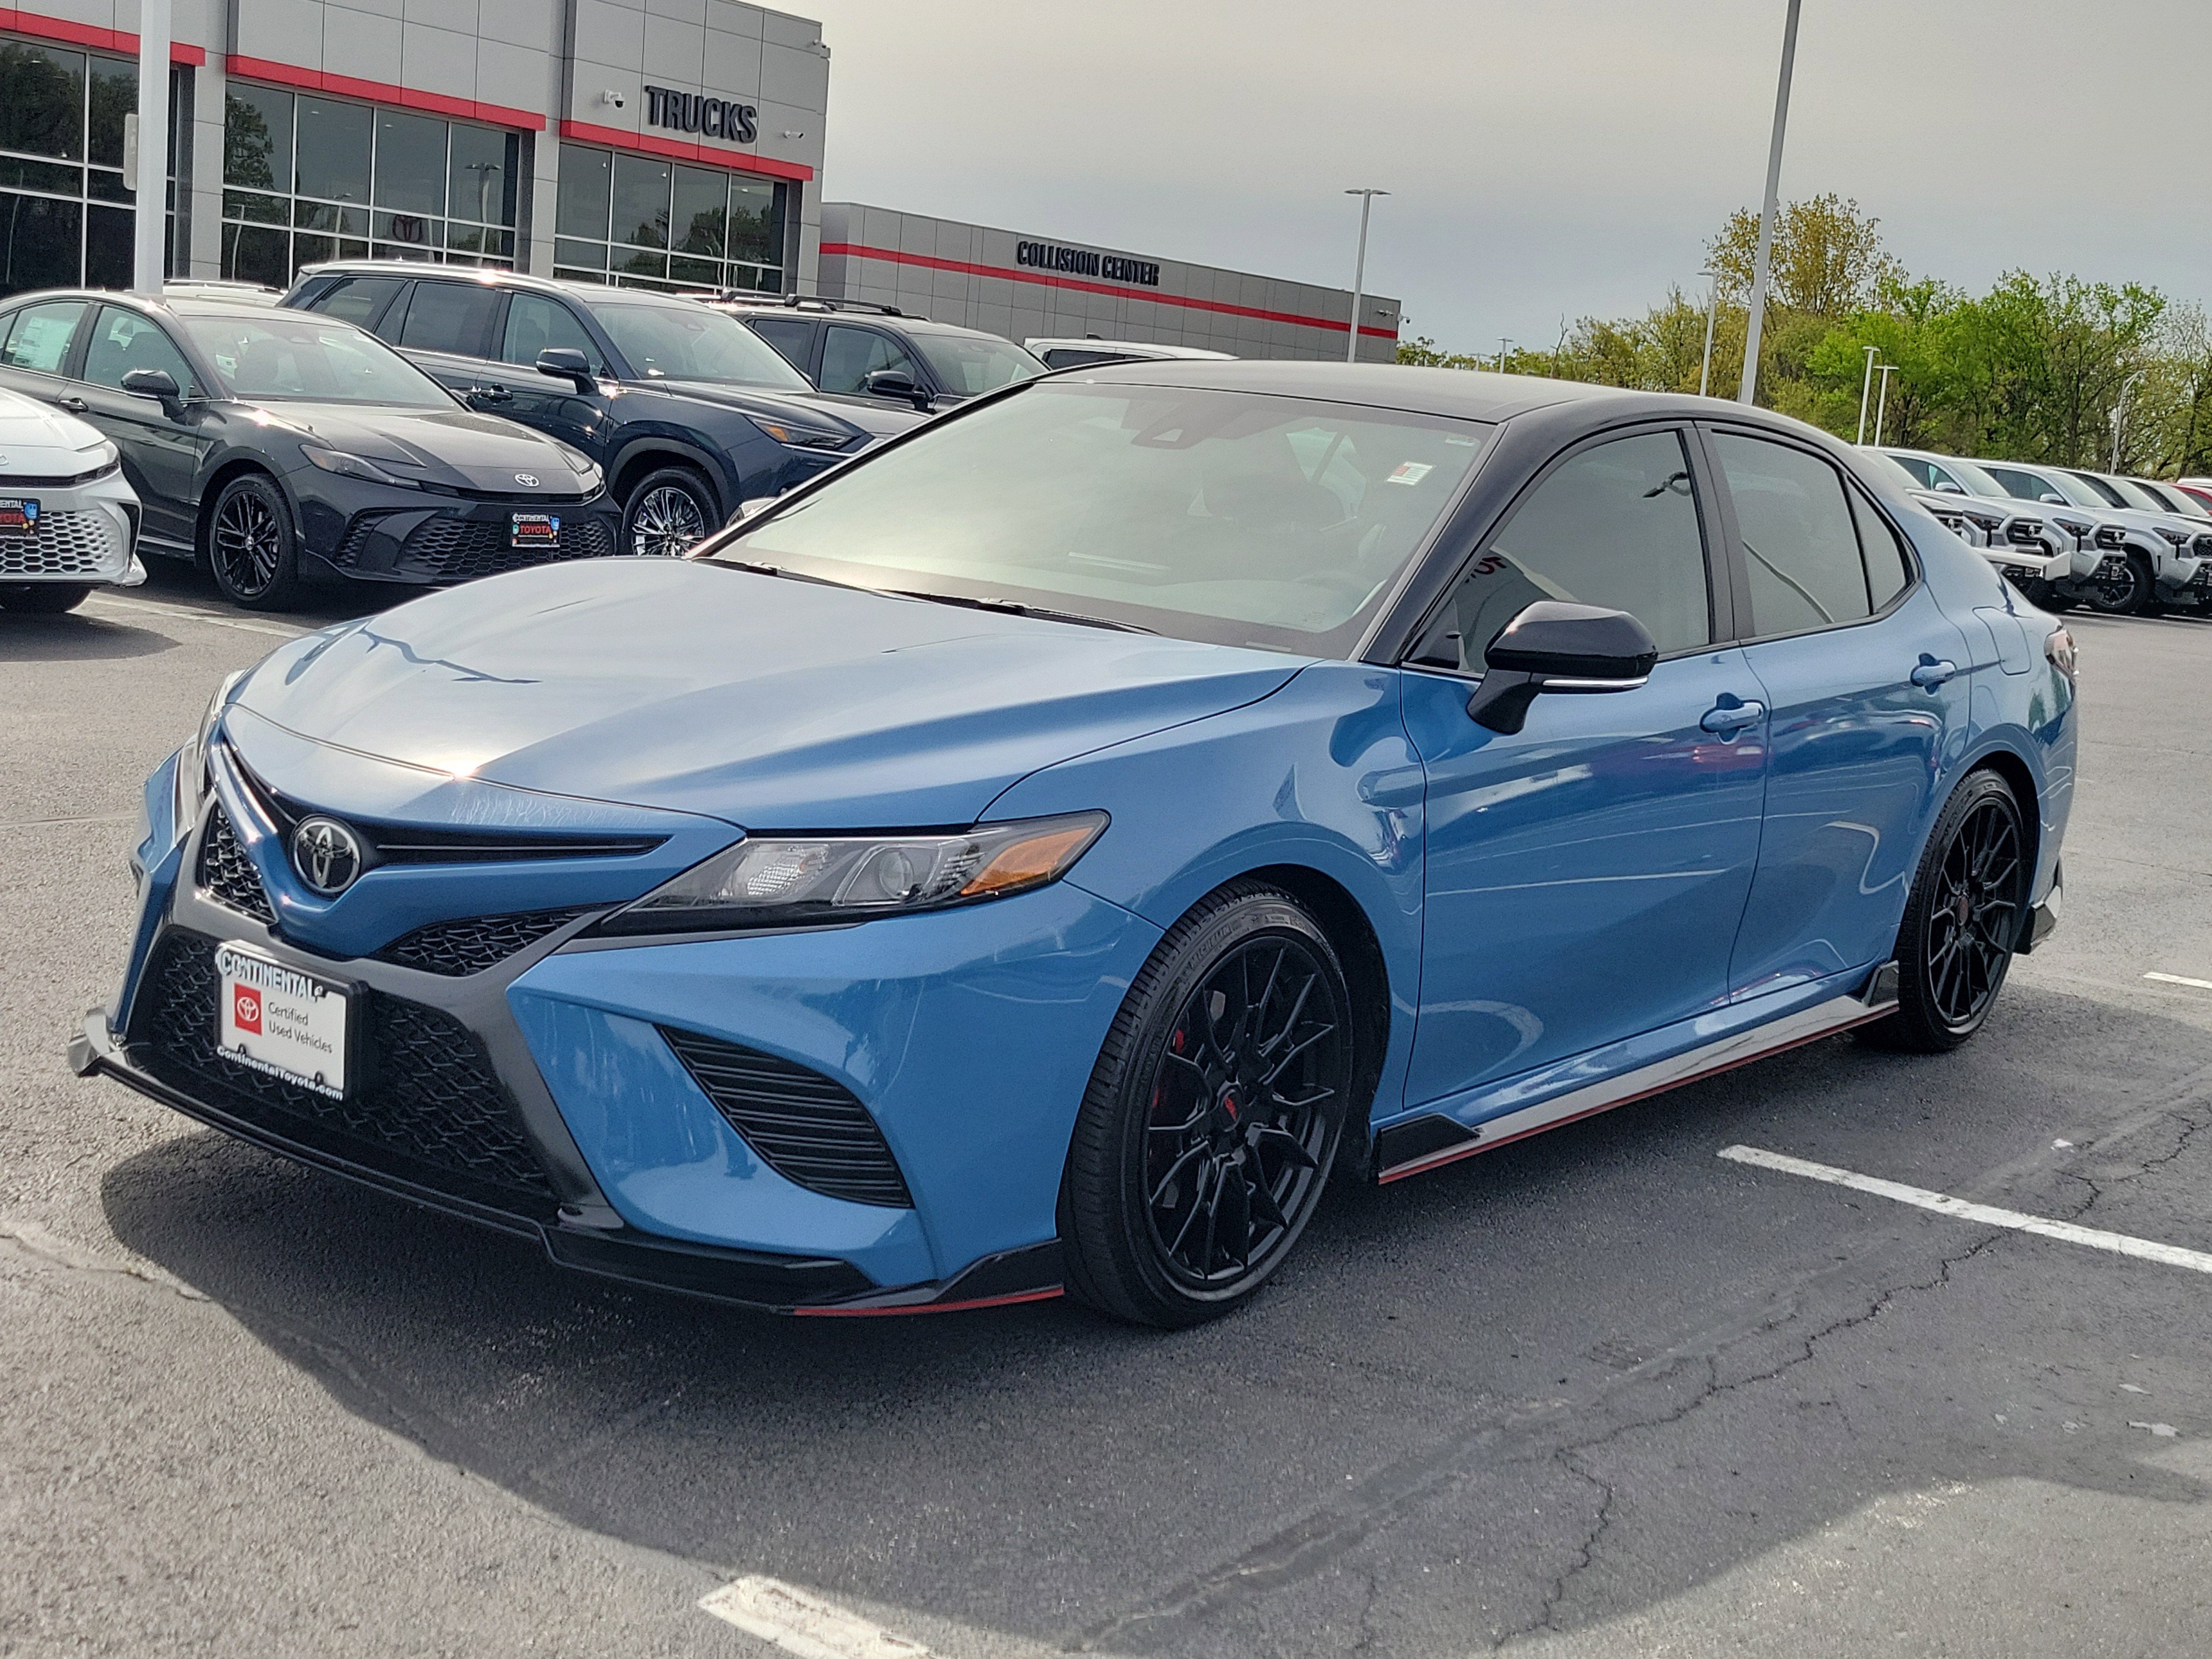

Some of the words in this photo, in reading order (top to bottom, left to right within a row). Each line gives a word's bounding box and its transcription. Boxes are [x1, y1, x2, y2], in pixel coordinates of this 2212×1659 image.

[645, 85, 757, 143] TRUCKS
[1017, 240, 1100, 276] COLLISION
[1102, 256, 1160, 286] CENTER
[520, 524, 552, 534] TOYOTA
[215, 946, 318, 1002] CONTINENTAL
[268, 1001, 308, 1026] Certified
[269, 1020, 292, 1039] Used
[294, 1029, 332, 1054] Vehicles
